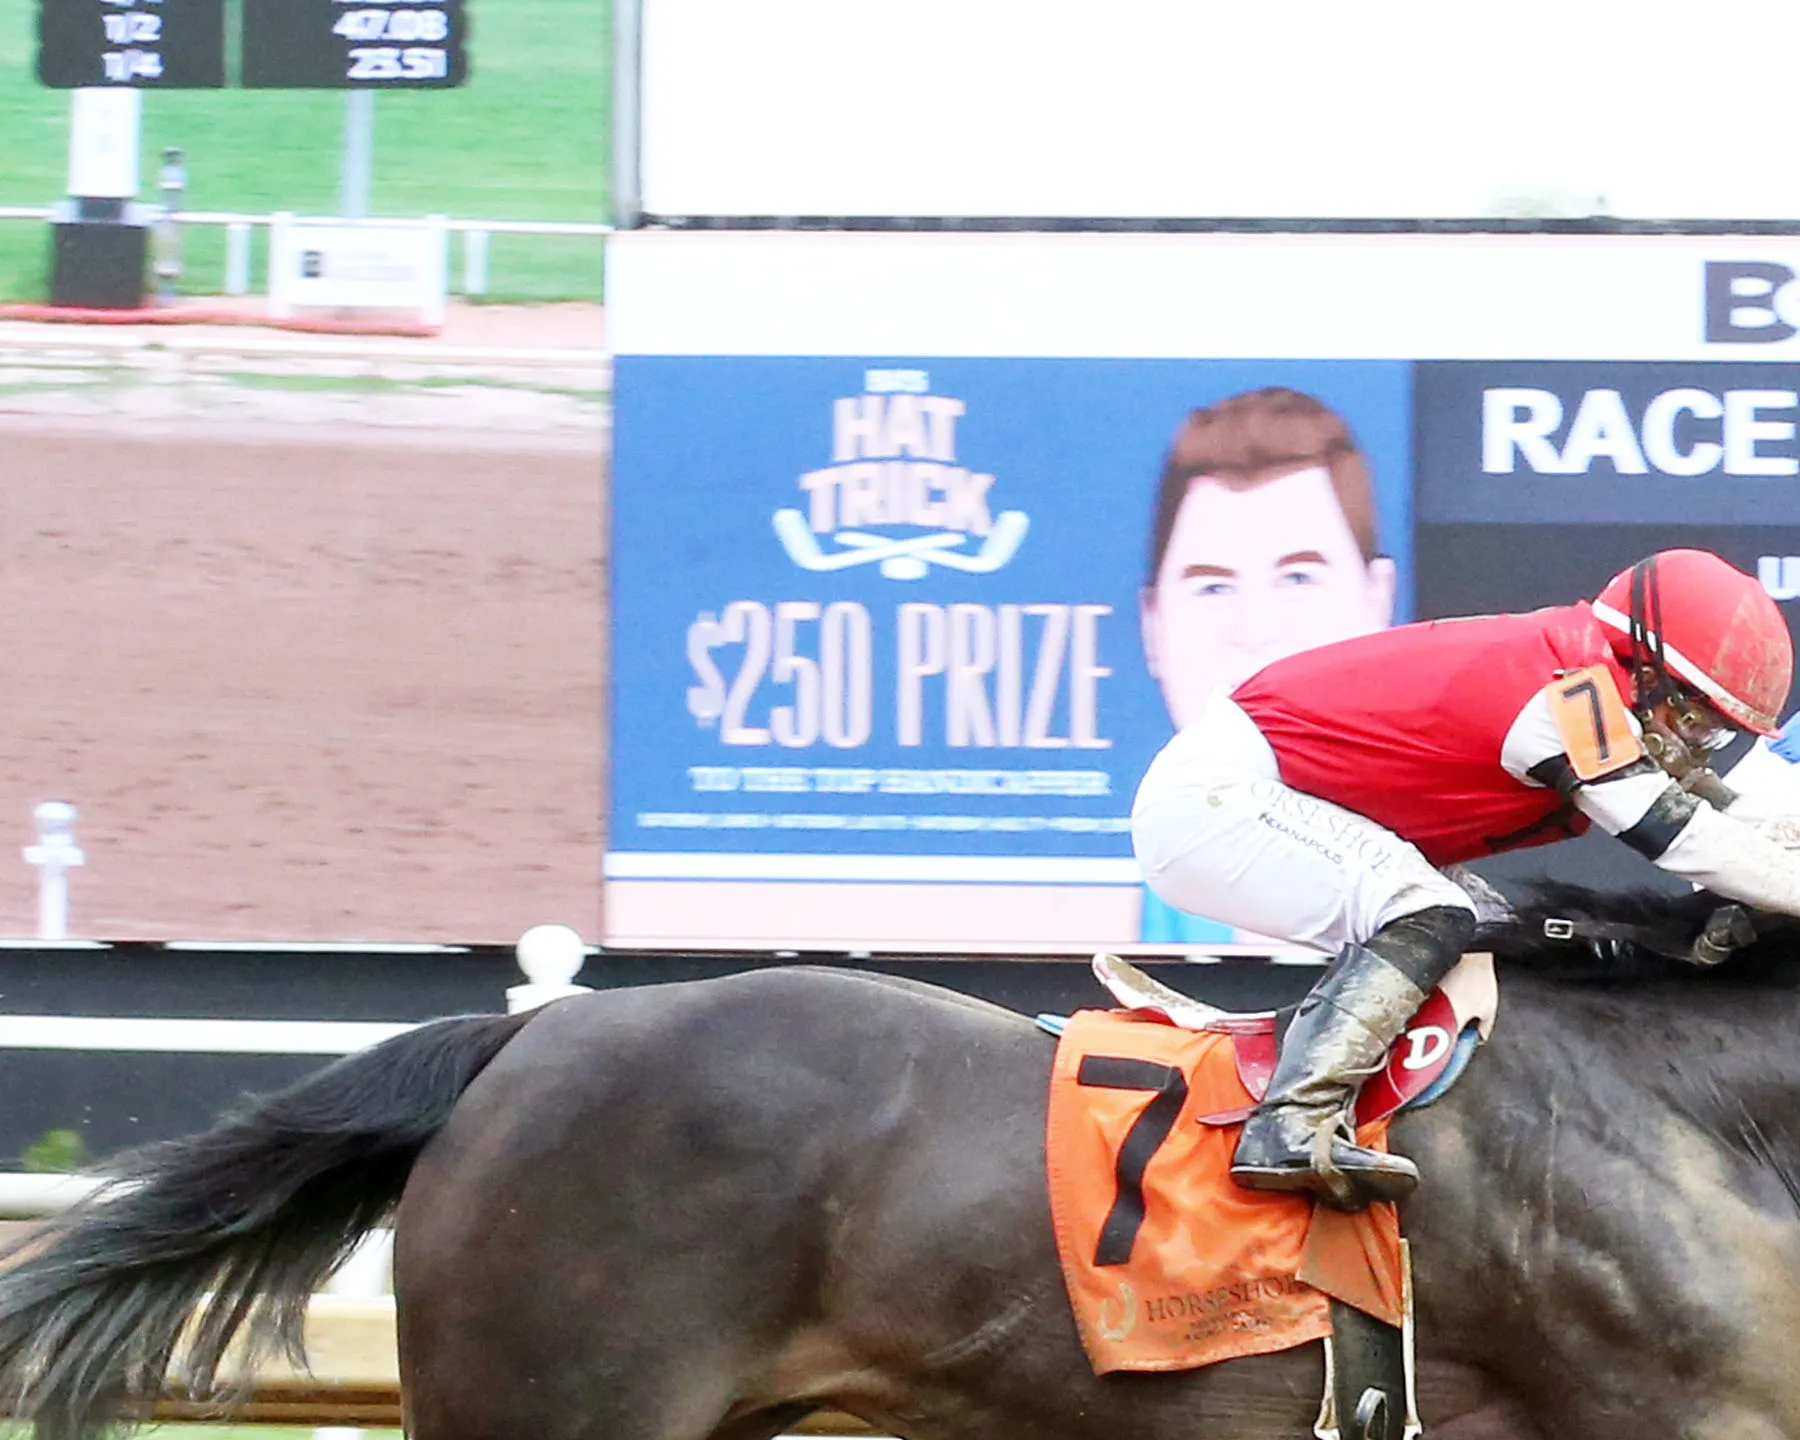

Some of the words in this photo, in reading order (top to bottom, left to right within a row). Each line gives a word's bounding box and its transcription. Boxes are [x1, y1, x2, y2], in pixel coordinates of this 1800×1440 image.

[832, 394, 968, 462] HAT
[1481, 387, 1799, 476] RACE
[799, 461, 997, 537] TRICK
[687, 600, 873, 748] $250
[897, 602, 1114, 749] PRIZE
[1560, 679, 1613, 764] 7
[1402, 1026, 1452, 1070] D
[1076, 1053, 1189, 1268] 7
